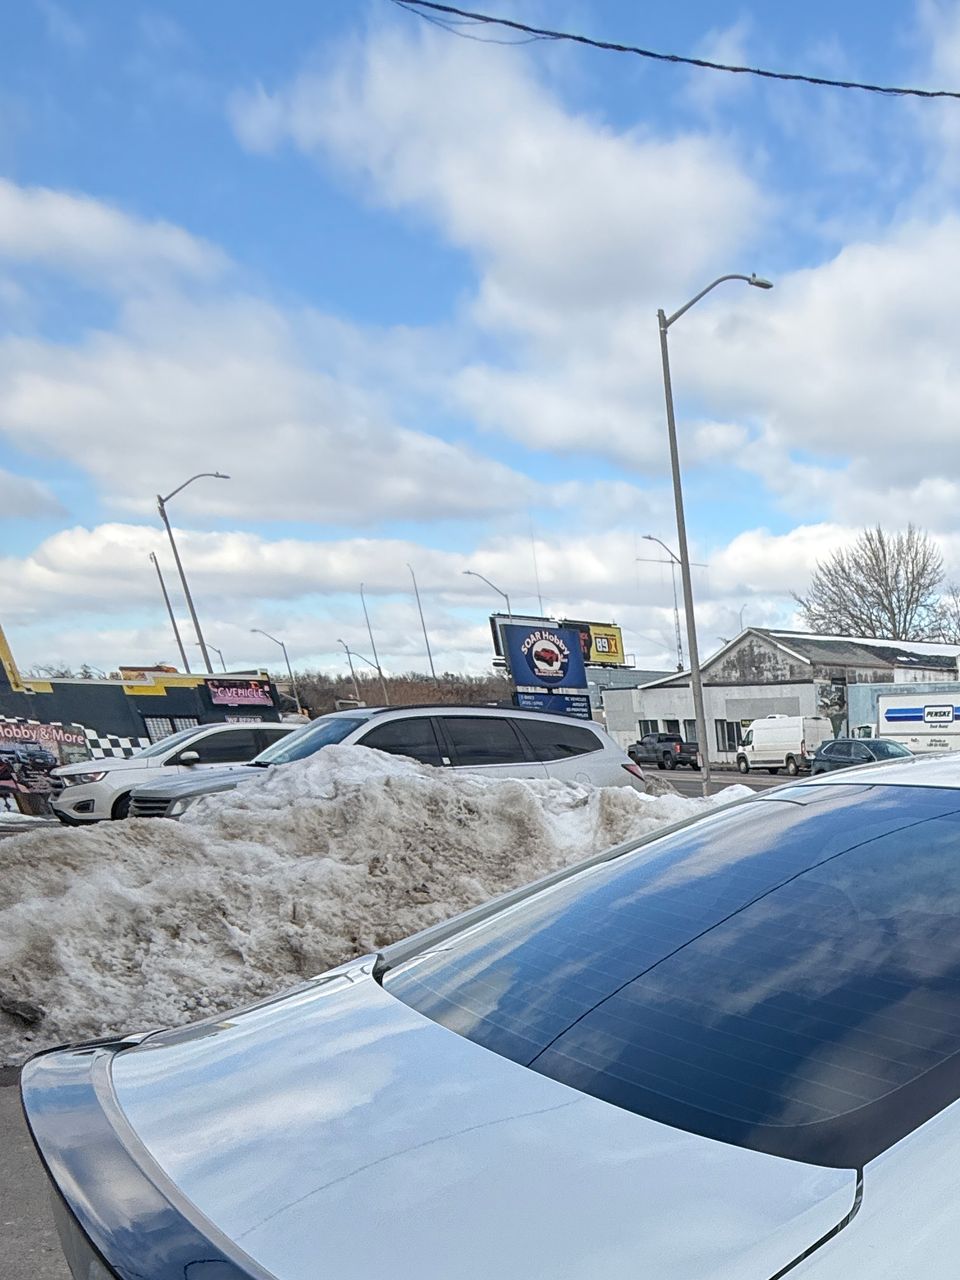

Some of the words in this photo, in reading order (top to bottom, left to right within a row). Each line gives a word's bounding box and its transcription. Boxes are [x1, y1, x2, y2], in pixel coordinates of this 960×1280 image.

[521, 631, 541, 655] SOAR
[542, 631, 570, 655] Hobby
[40, 728, 49, 739] &
[52, 729, 84, 744] More
